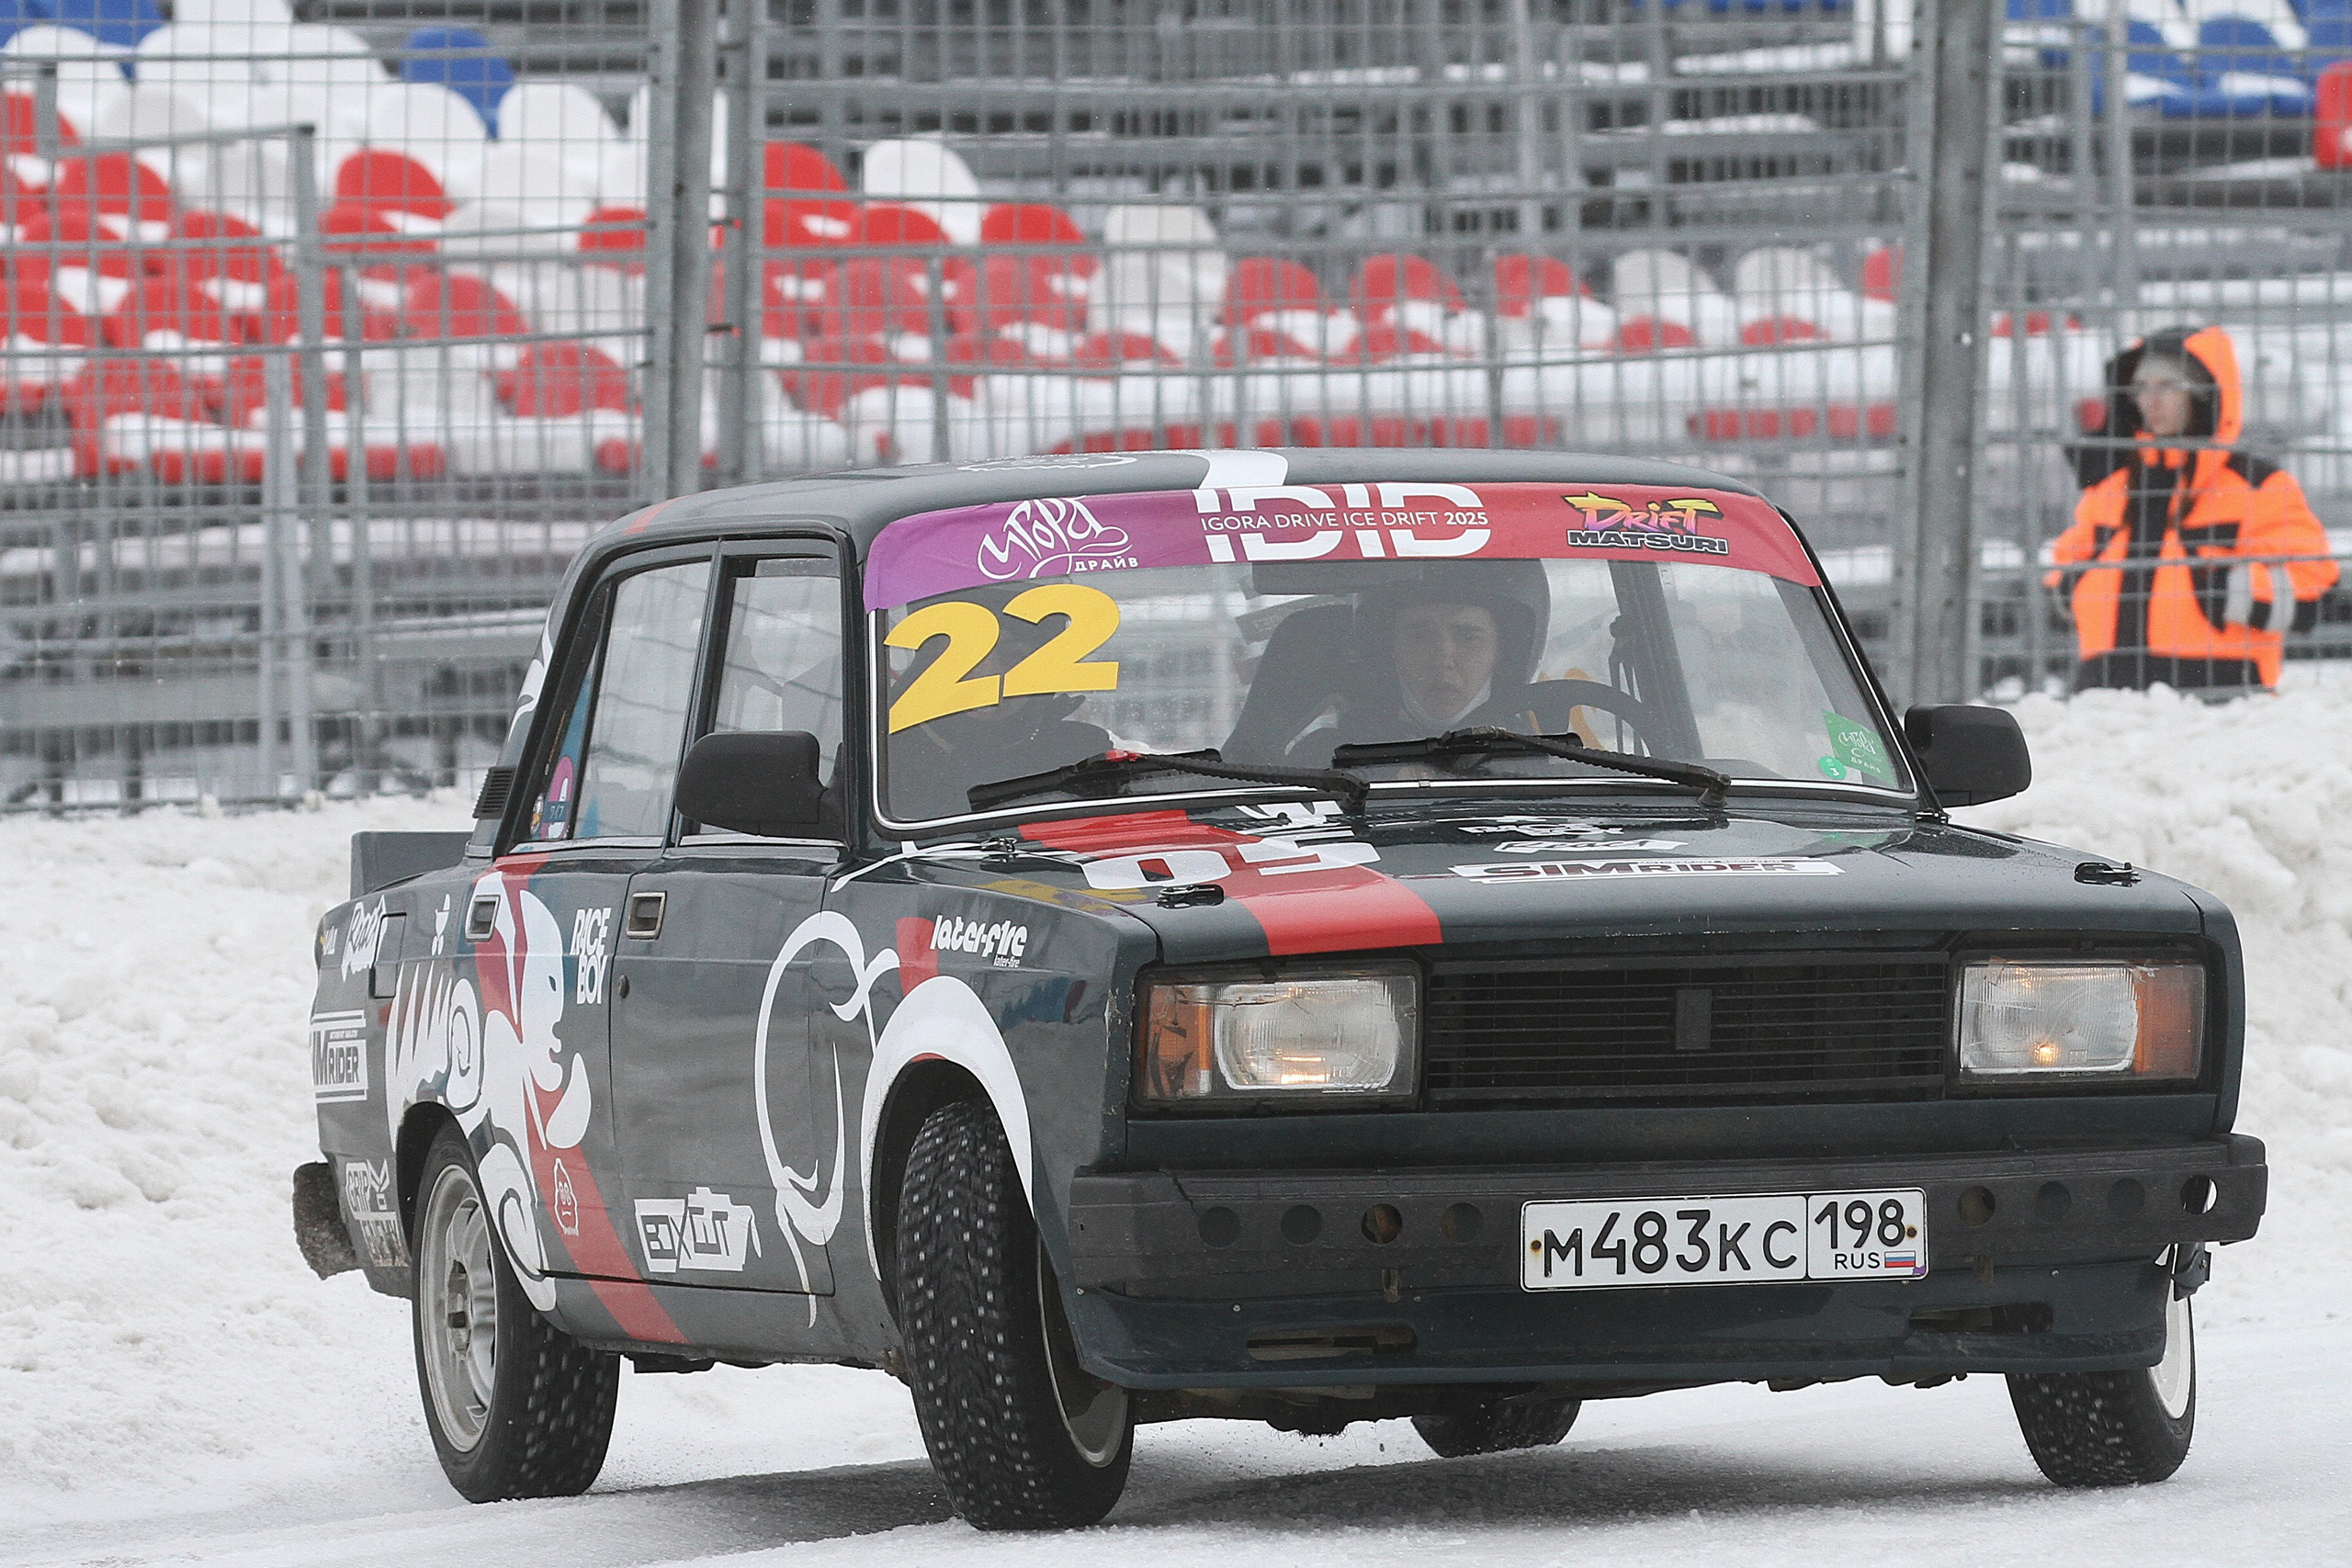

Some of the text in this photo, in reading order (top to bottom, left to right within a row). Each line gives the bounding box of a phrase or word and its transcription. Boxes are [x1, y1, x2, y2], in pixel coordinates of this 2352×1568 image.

[1201, 511, 1489, 531] IGORA DRIVE ICE DRIFT 2025
[1566, 530, 1729, 555] MATSURI
[1074, 557, 1139, 571] ДРАЙВ
[885, 583, 1120, 734] 22
[1483, 861, 1801, 877] SIMRIDER
[569, 908, 612, 956] RACE
[993, 954, 1021, 968] later-fire
[576, 954, 608, 1005] BOY
[1814, 1199, 1905, 1249] 198
[1834, 1251, 1881, 1270] RUS
